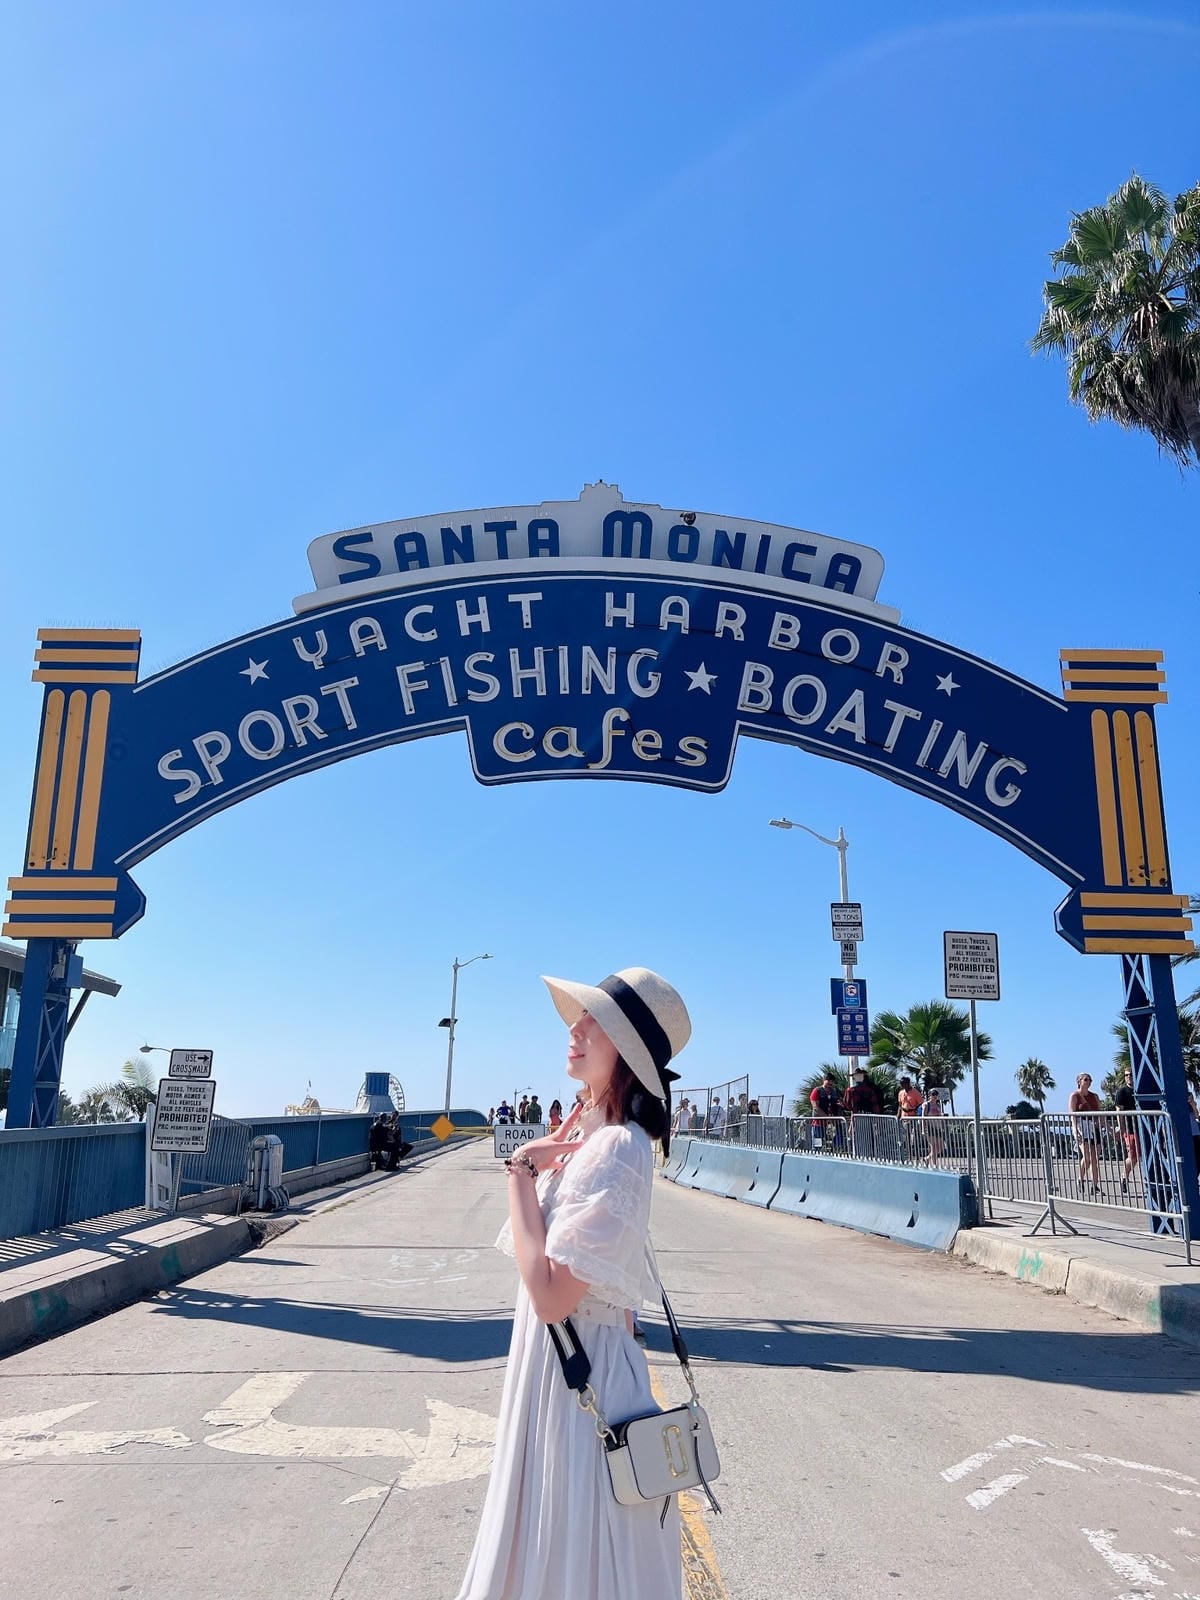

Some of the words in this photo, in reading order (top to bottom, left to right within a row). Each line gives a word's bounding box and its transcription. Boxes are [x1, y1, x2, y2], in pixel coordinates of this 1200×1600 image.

[332, 518, 559, 583] SANTA
[602, 510, 862, 595] MONICA
[292, 592, 543, 670] YACHT
[604, 591, 910, 685] HARBOR
[157, 676, 360, 804] SPORT
[396, 645, 662, 716] FISHING
[736, 660, 1028, 808] BOATING
[844, 944, 854, 952] NO
[949, 963, 995, 972] PROHIBITED
[186, 1054, 196, 1062] USE
[172, 1064, 208, 1073] CROSSWALK
[160, 1113, 207, 1123] PROHIBITED
[505, 1130, 534, 1139] ROAD
[500, 1143, 524, 1153] CLO
